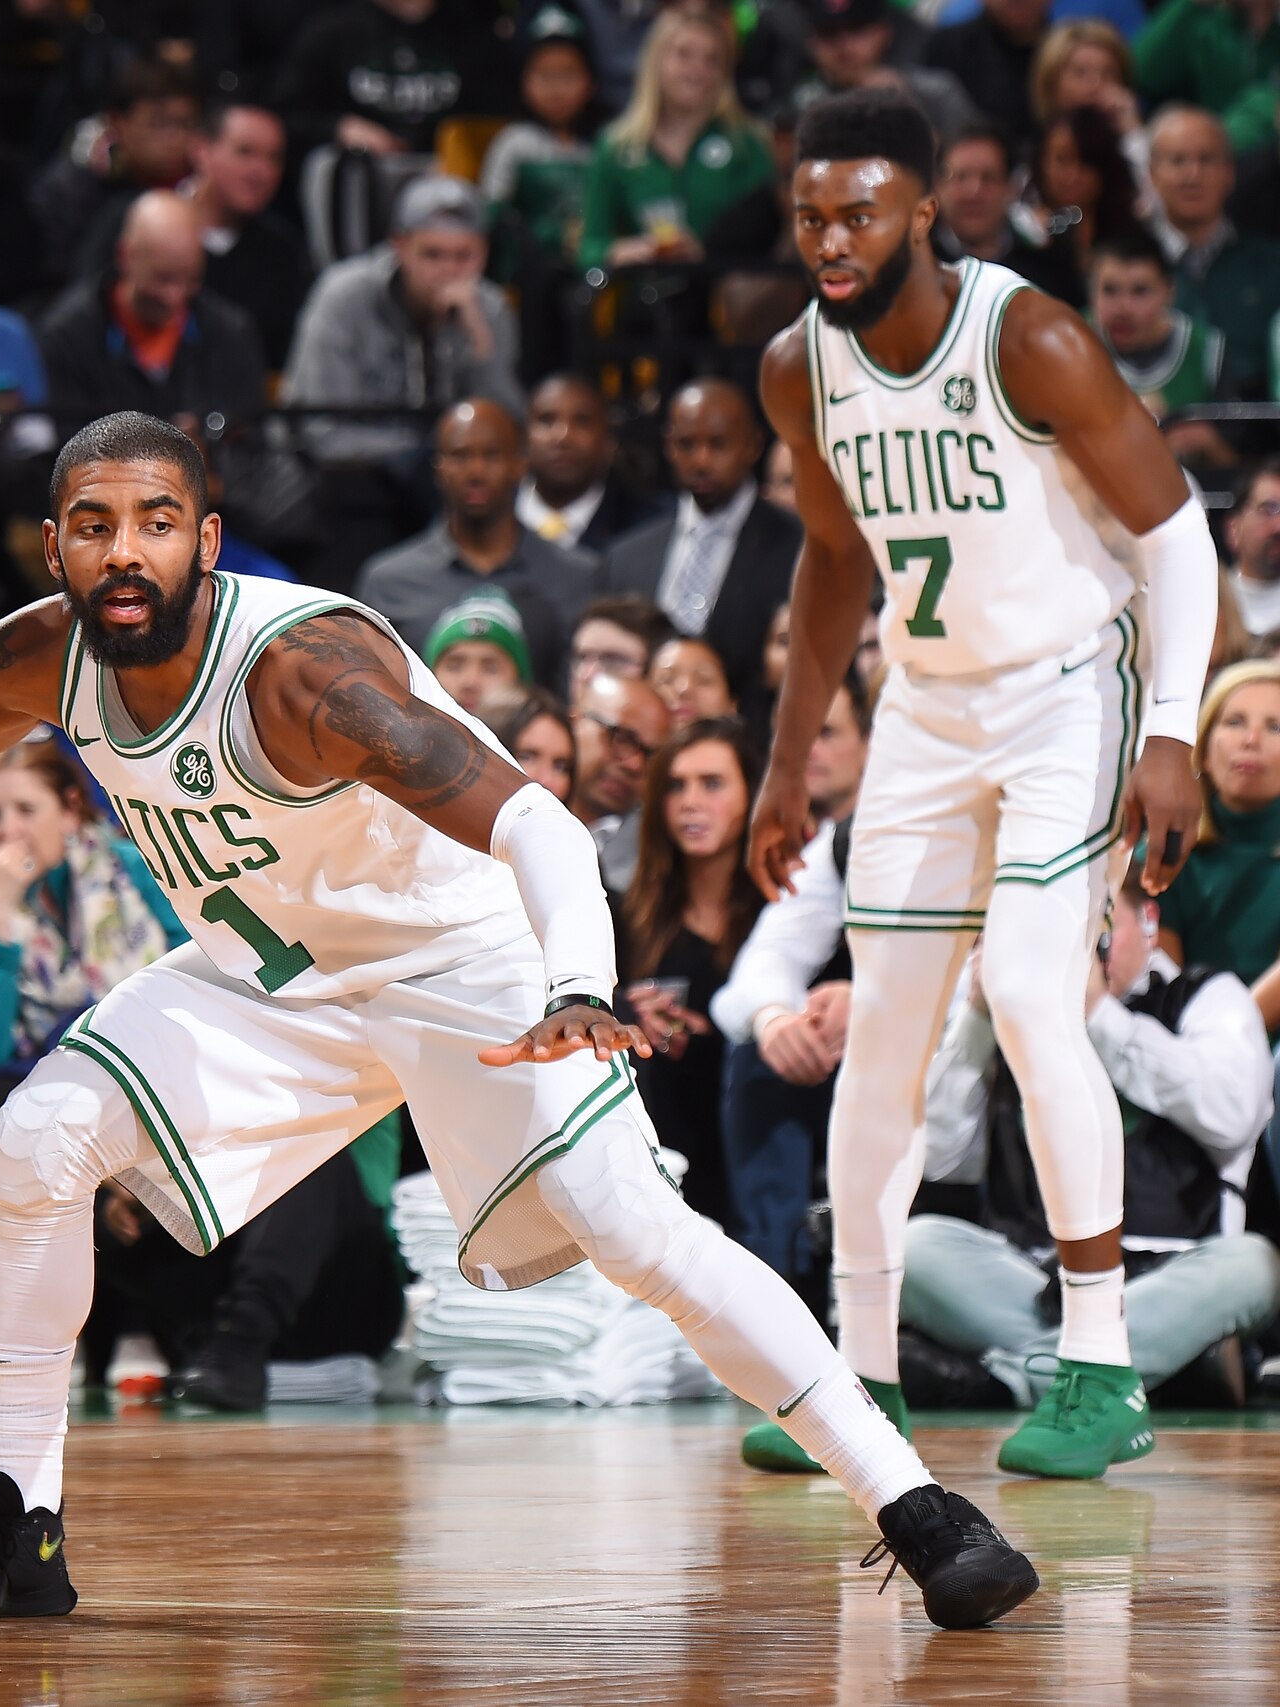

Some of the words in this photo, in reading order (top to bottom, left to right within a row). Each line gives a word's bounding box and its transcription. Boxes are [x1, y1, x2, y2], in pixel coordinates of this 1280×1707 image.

[833, 429, 1007, 519] CELTICS
[886, 536, 954, 638] 7
[200, 885, 316, 996] 1
